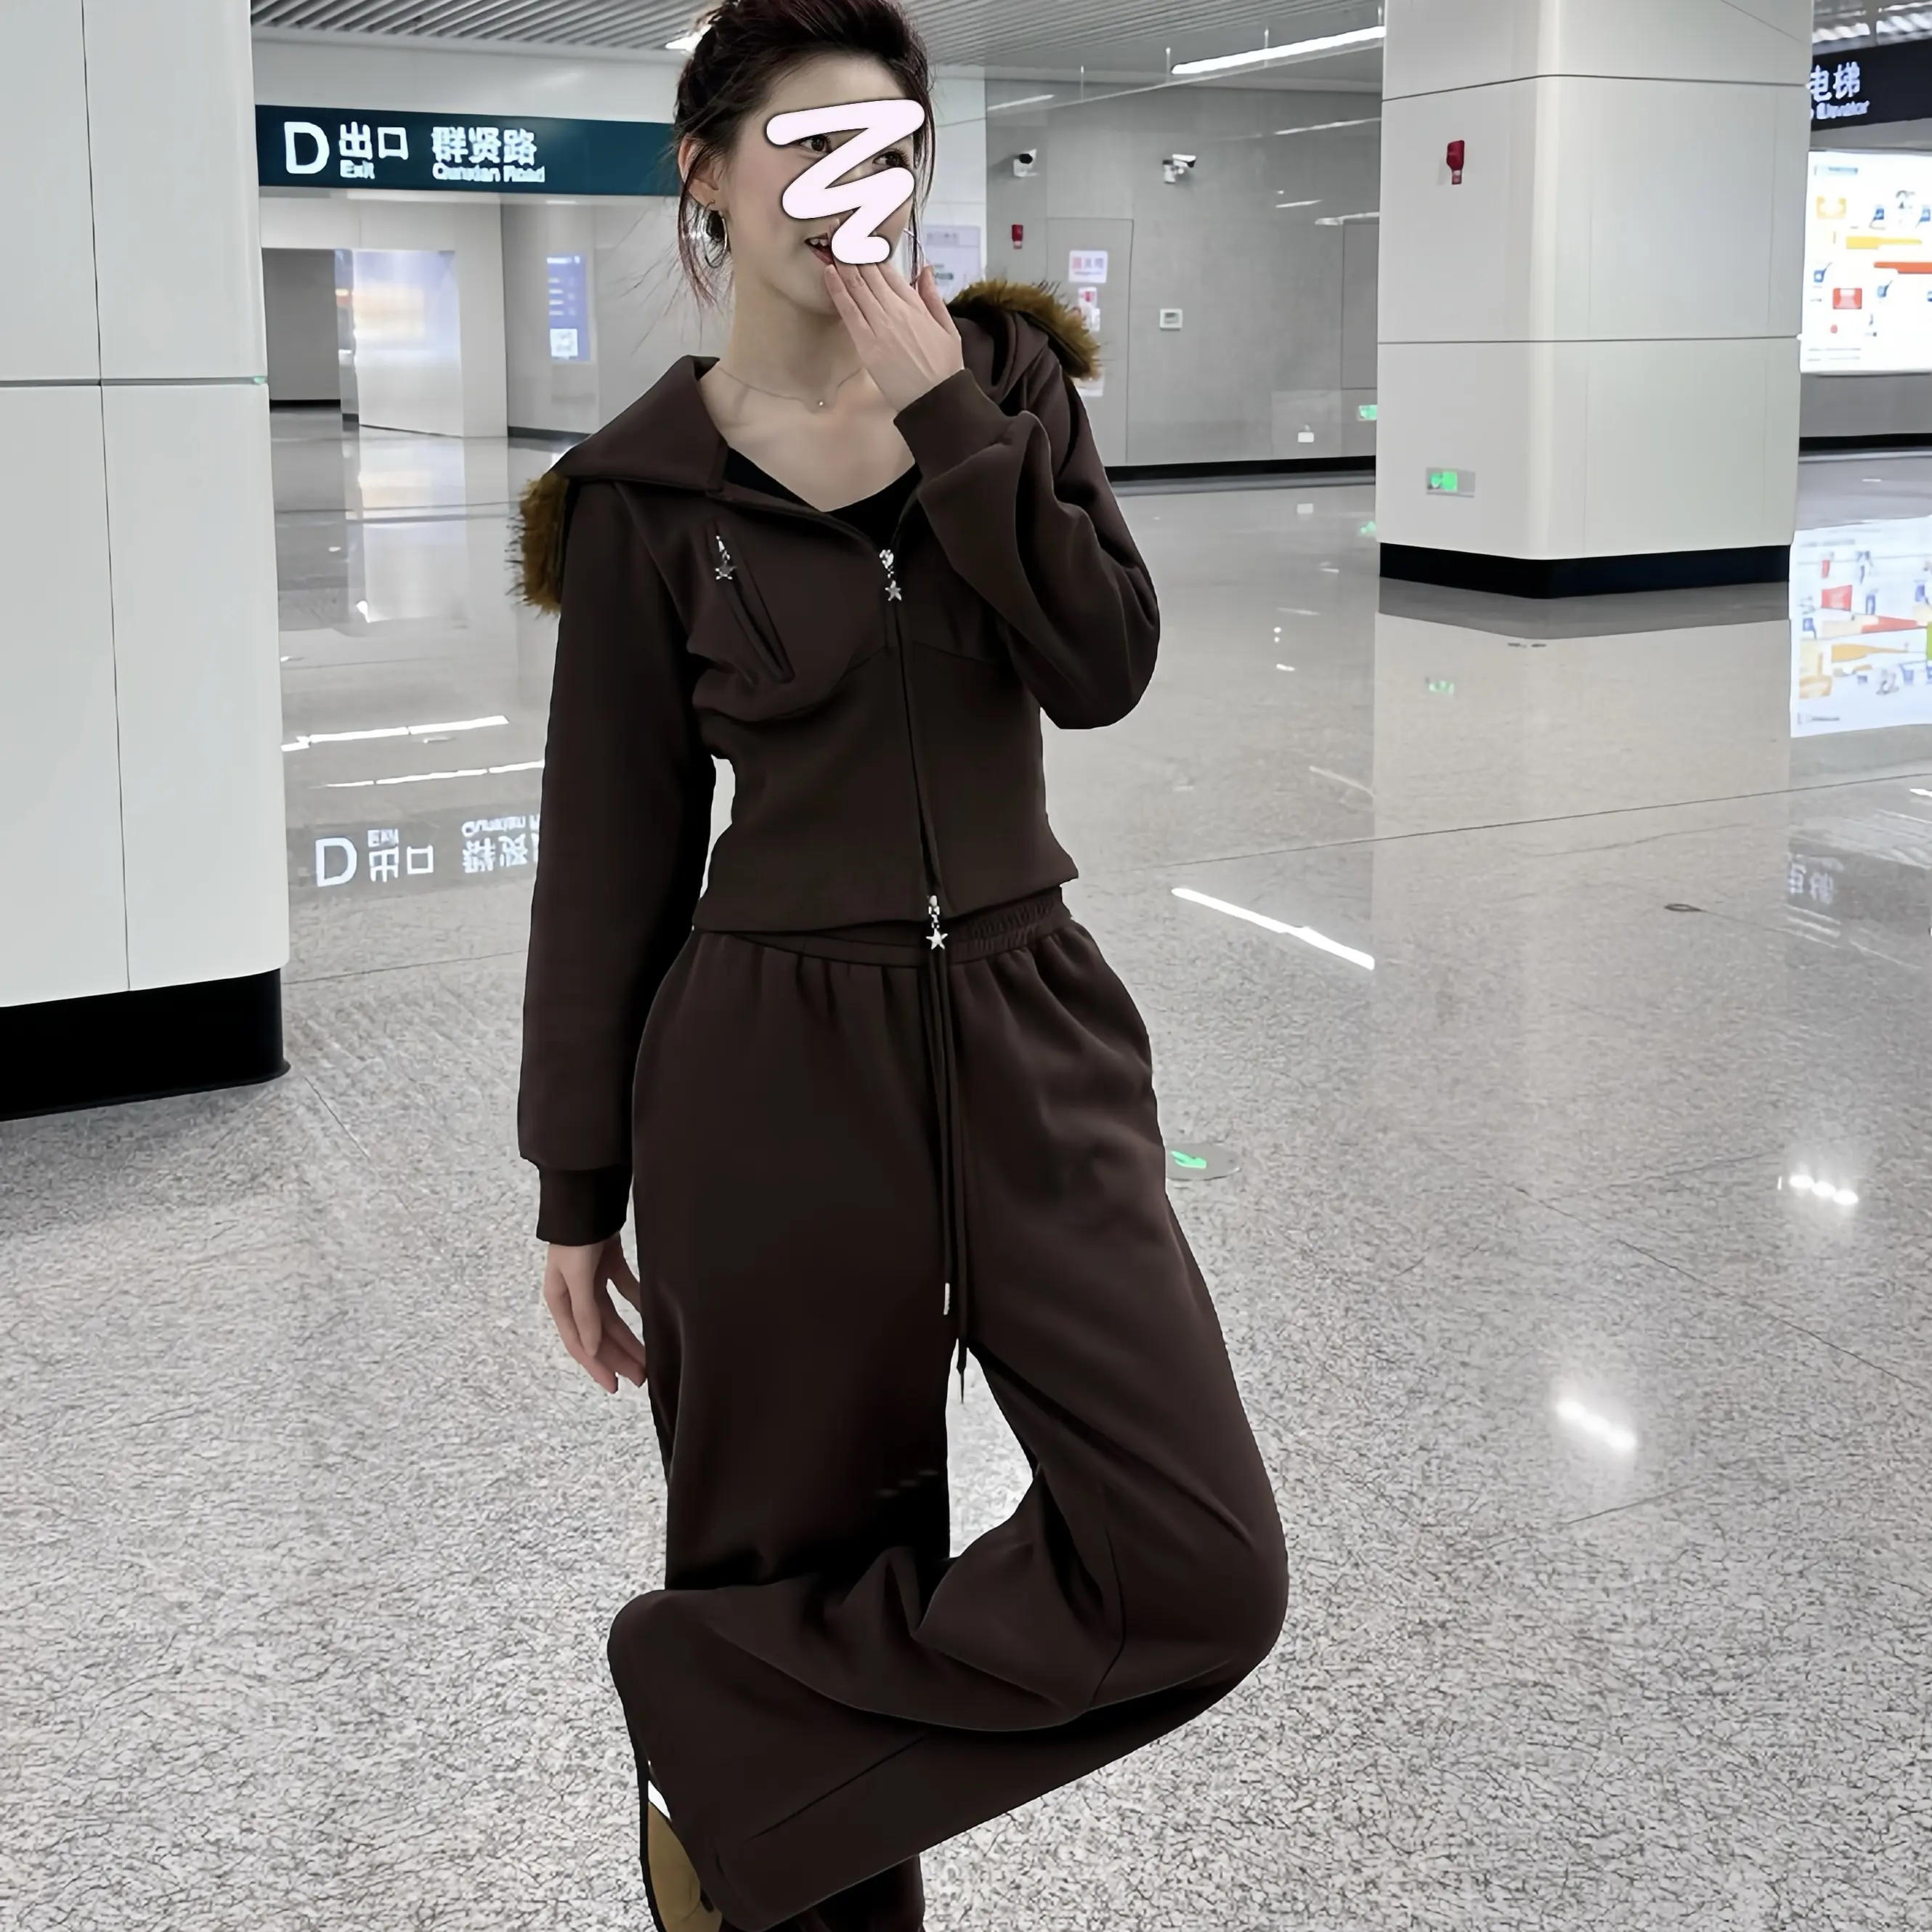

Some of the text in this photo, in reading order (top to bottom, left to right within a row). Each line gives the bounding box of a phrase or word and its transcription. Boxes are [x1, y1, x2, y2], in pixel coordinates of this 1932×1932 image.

[1809, 61, 1860, 102] 电梯
[284, 121, 537, 174] D 出口 群贤路
